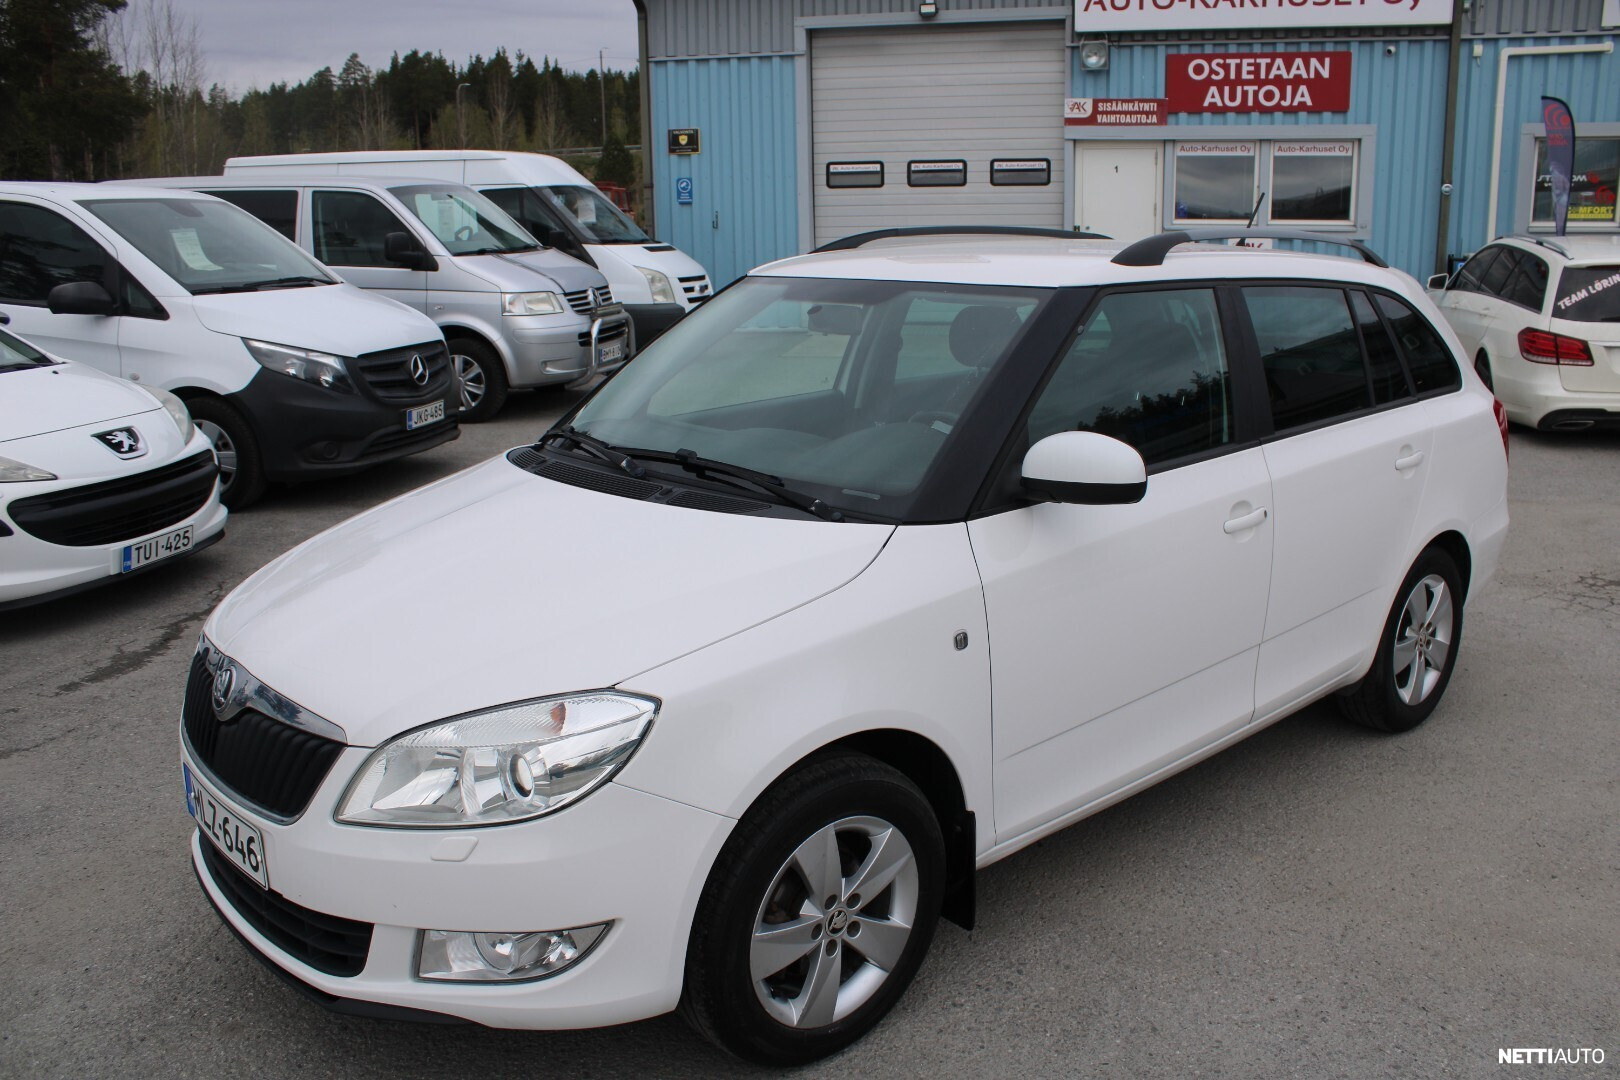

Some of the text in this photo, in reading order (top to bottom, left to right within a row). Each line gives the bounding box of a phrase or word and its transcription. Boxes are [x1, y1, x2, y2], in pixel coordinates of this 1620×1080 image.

[1188, 57, 1330, 81] OSTETAAN
[1203, 85, 1313, 107] AUTOJA
[1098, 101, 1157, 112] SISÄÄNKÄYNTI
[1097, 114, 1158, 124] VAIHTOAUTOJA
[1180, 144, 1251, 153] Auto-Karhuset Oy
[1277, 144, 1350, 153] Auto-Karhuset Oy
[1114, 165, 1119, 173] 1
[1558, 289, 1588, 309] TEAM
[414, 404, 443, 425] JKG-485
[135, 530, 190, 563] TUI-425
